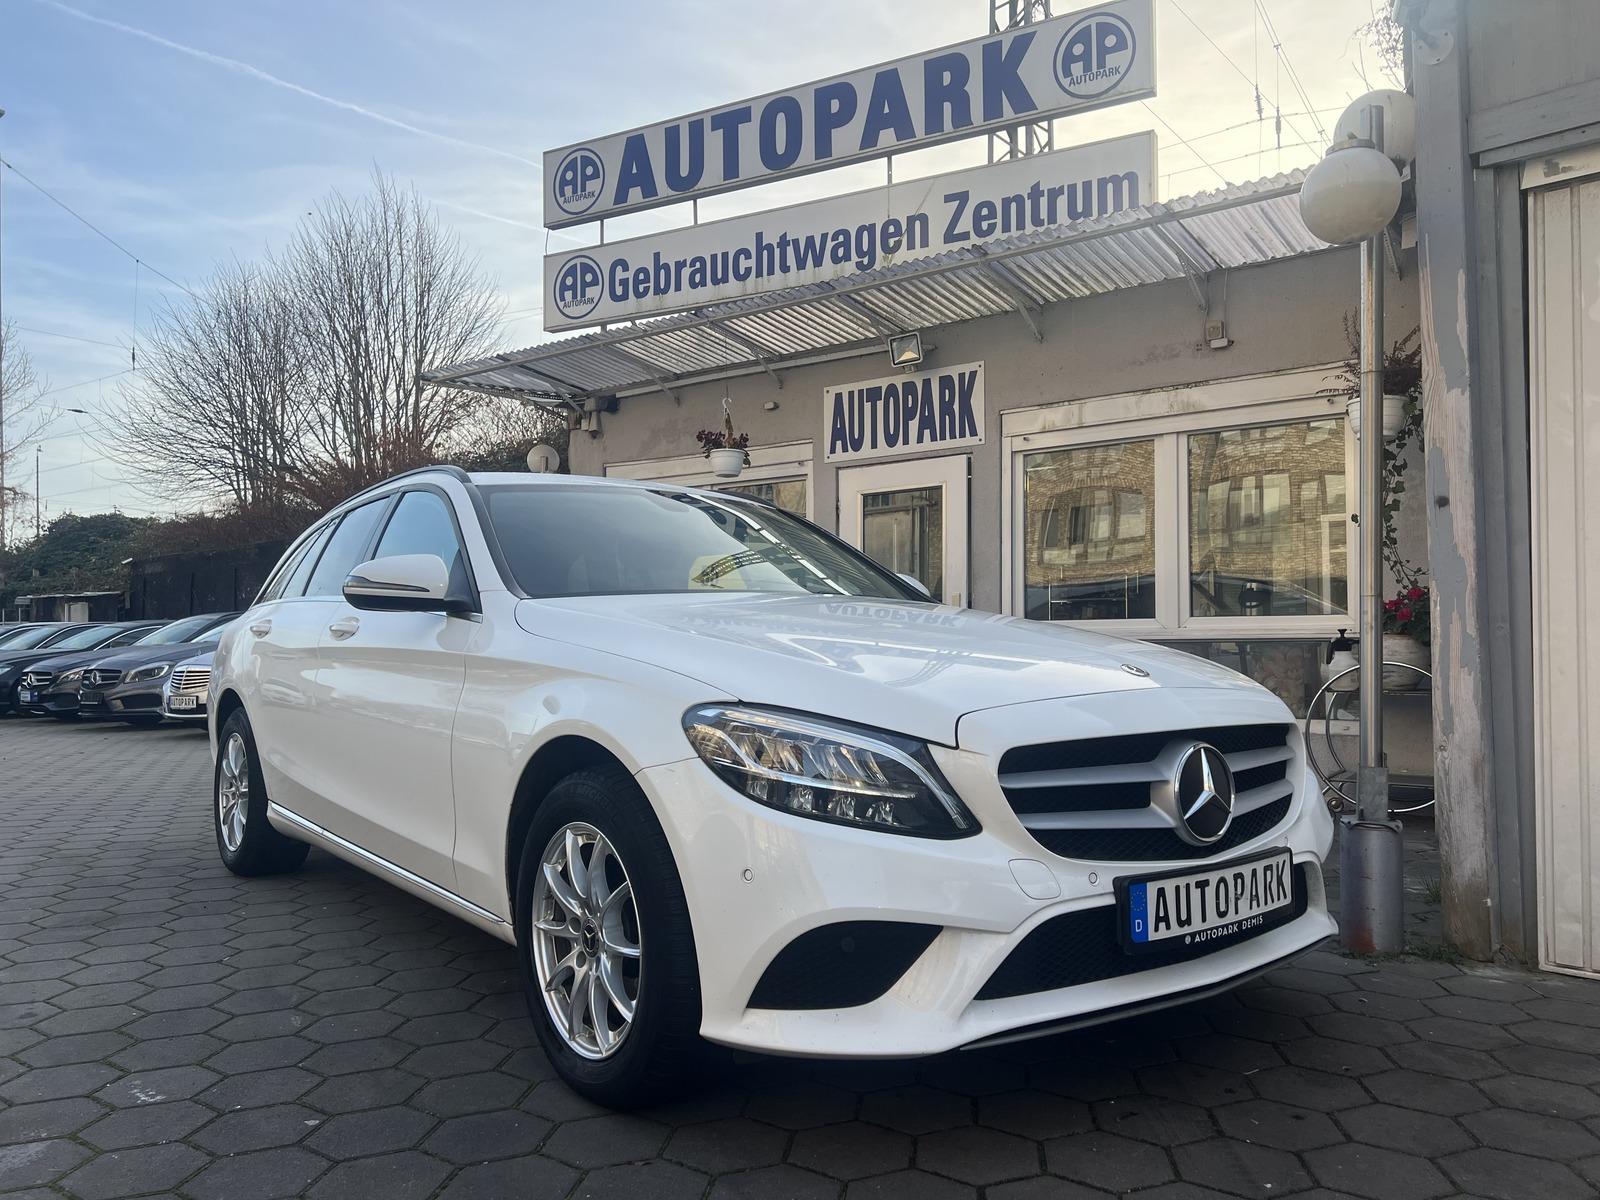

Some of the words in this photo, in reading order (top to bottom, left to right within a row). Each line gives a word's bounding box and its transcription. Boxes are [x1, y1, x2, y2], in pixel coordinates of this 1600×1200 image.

[1061, 22, 1129, 79] AP
[1068, 65, 1121, 87] AUTOPARK
[613, 31, 1039, 206] AUTOPARK
[558, 155, 601, 198] AP
[562, 190, 596, 205] AUTOPARK
[608, 213, 930, 303] Gebrauchtwagen
[943, 171, 1140, 245] Zentrum
[558, 261, 600, 302] AP
[562, 296, 595, 309] AUTOPARK
[829, 370, 979, 455] AUTOPARK
[1135, 919, 1143, 933] D
[1153, 859, 1288, 933] AUTOPARK
[1194, 922, 1239, 944] AUTOPARK
[1241, 914, 1264, 930] DEMIS
